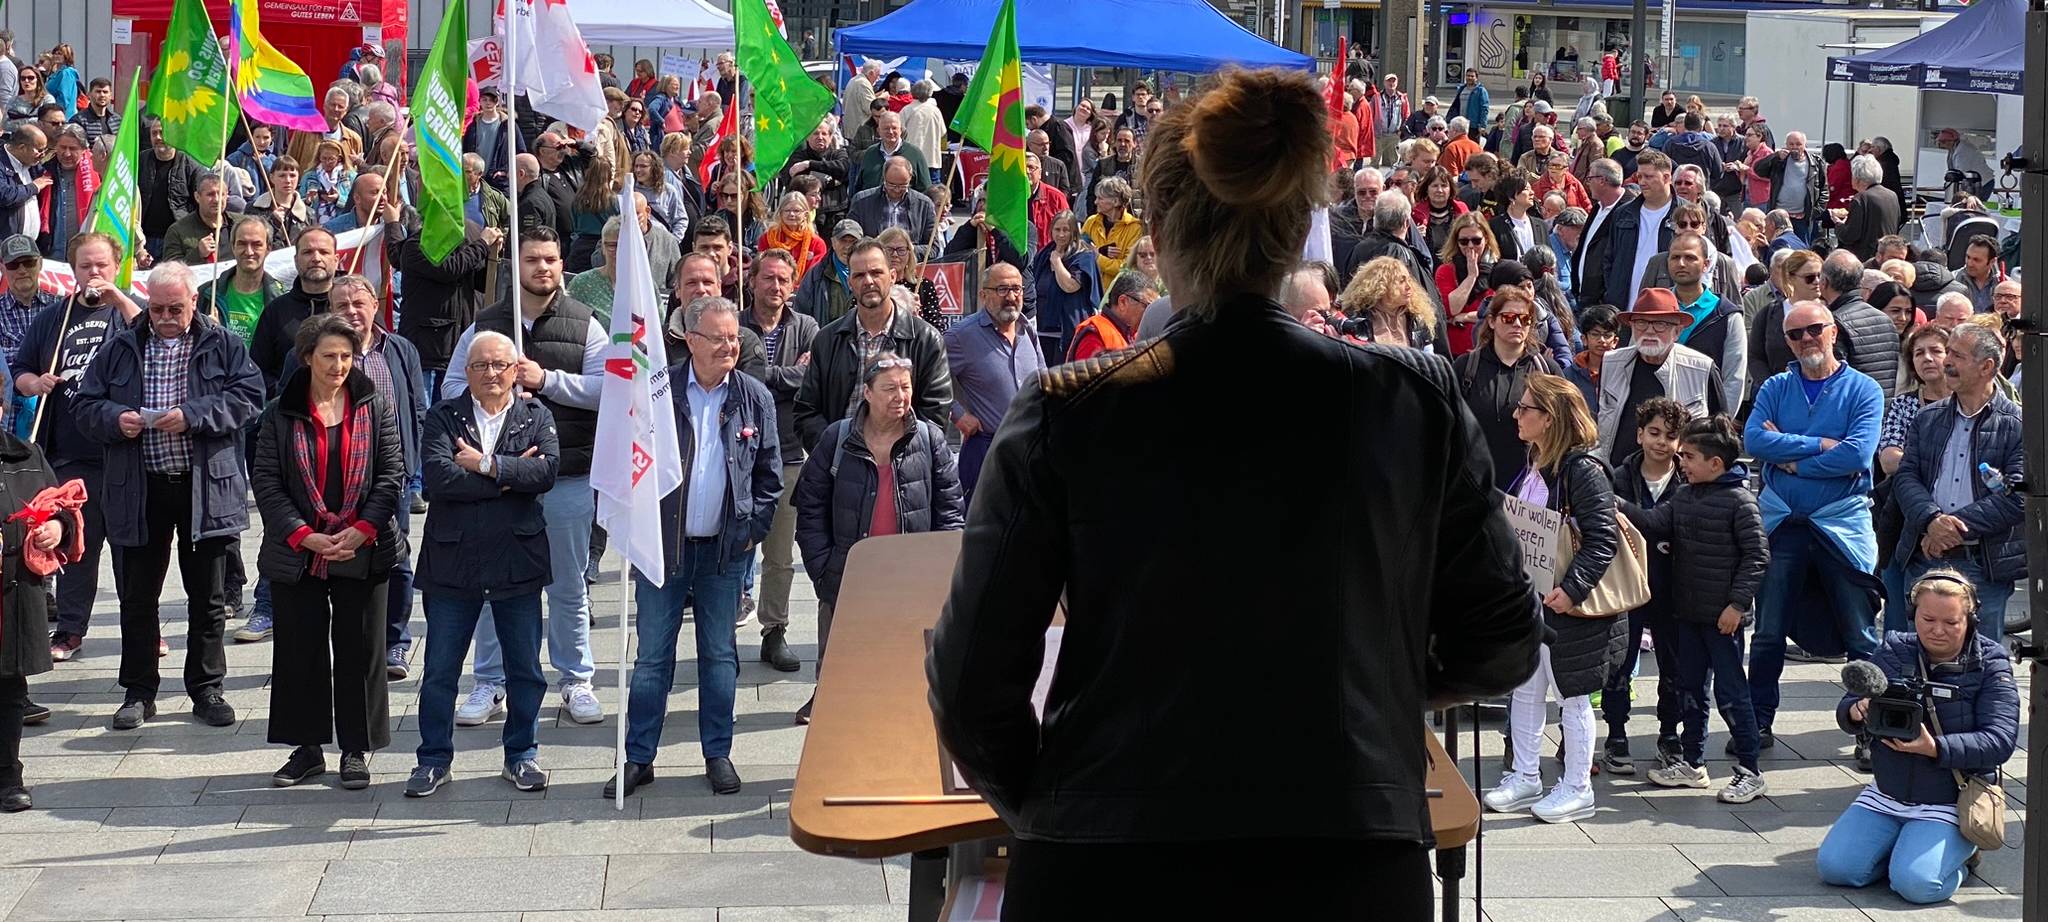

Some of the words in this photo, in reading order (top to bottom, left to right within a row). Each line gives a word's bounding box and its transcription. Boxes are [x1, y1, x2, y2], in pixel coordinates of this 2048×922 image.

[291, 10, 312, 18] GUTES
[313, 11, 335, 19] LEBEN
[1505, 498, 1526, 517] Wir
[1528, 509, 1557, 534] wollen
[1514, 527, 1545, 548] seren
